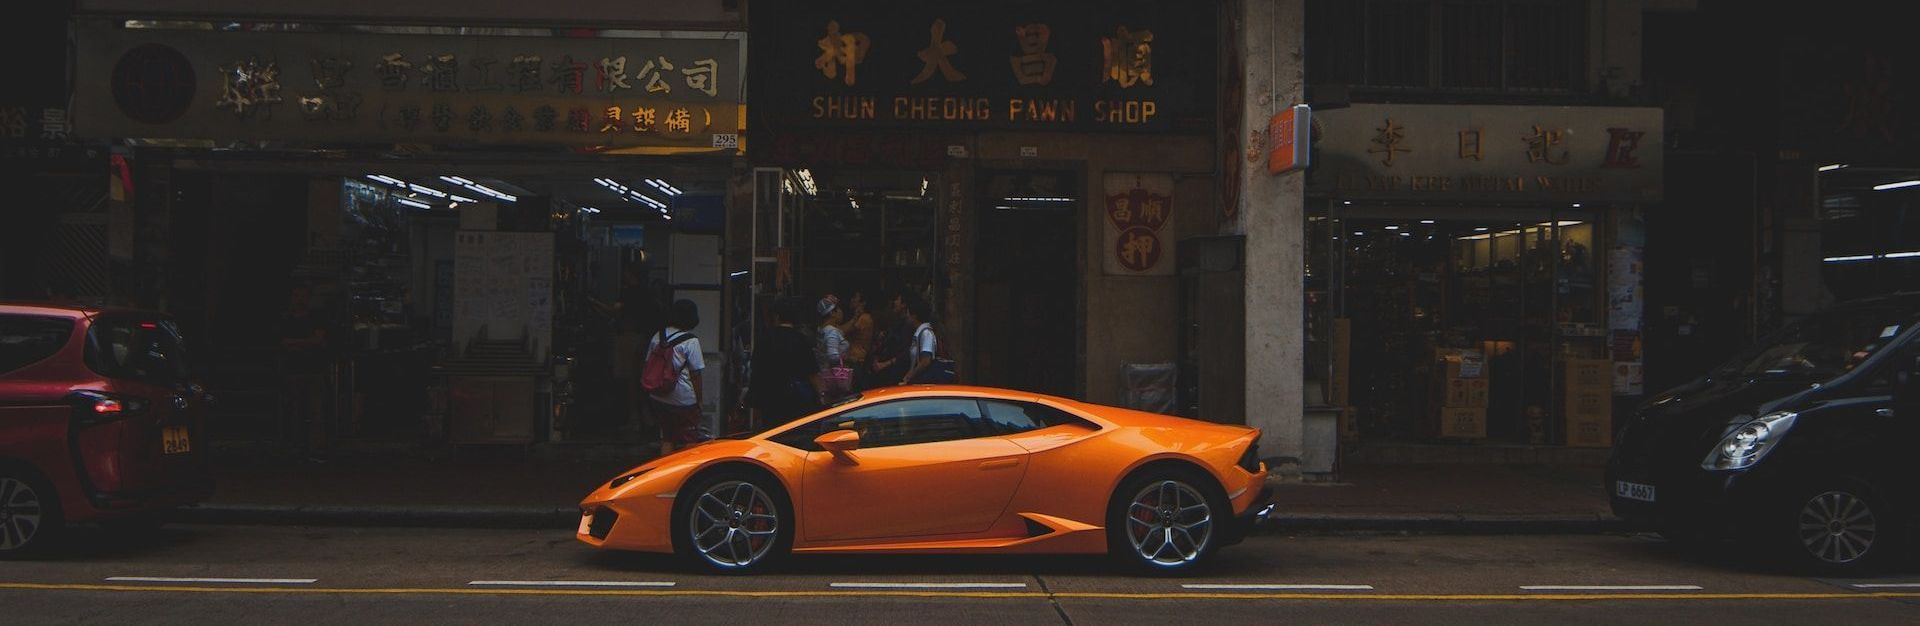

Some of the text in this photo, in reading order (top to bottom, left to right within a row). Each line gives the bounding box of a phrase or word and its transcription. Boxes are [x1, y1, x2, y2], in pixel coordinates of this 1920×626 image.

[812, 96, 877, 120] SHUN
[894, 96, 992, 121] CHEONG
[1095, 98, 1156, 123] SHOP
[715, 134, 736, 144] 295
[1367, 117, 1569, 167] 李日記
[1631, 484, 1653, 501] 6667
